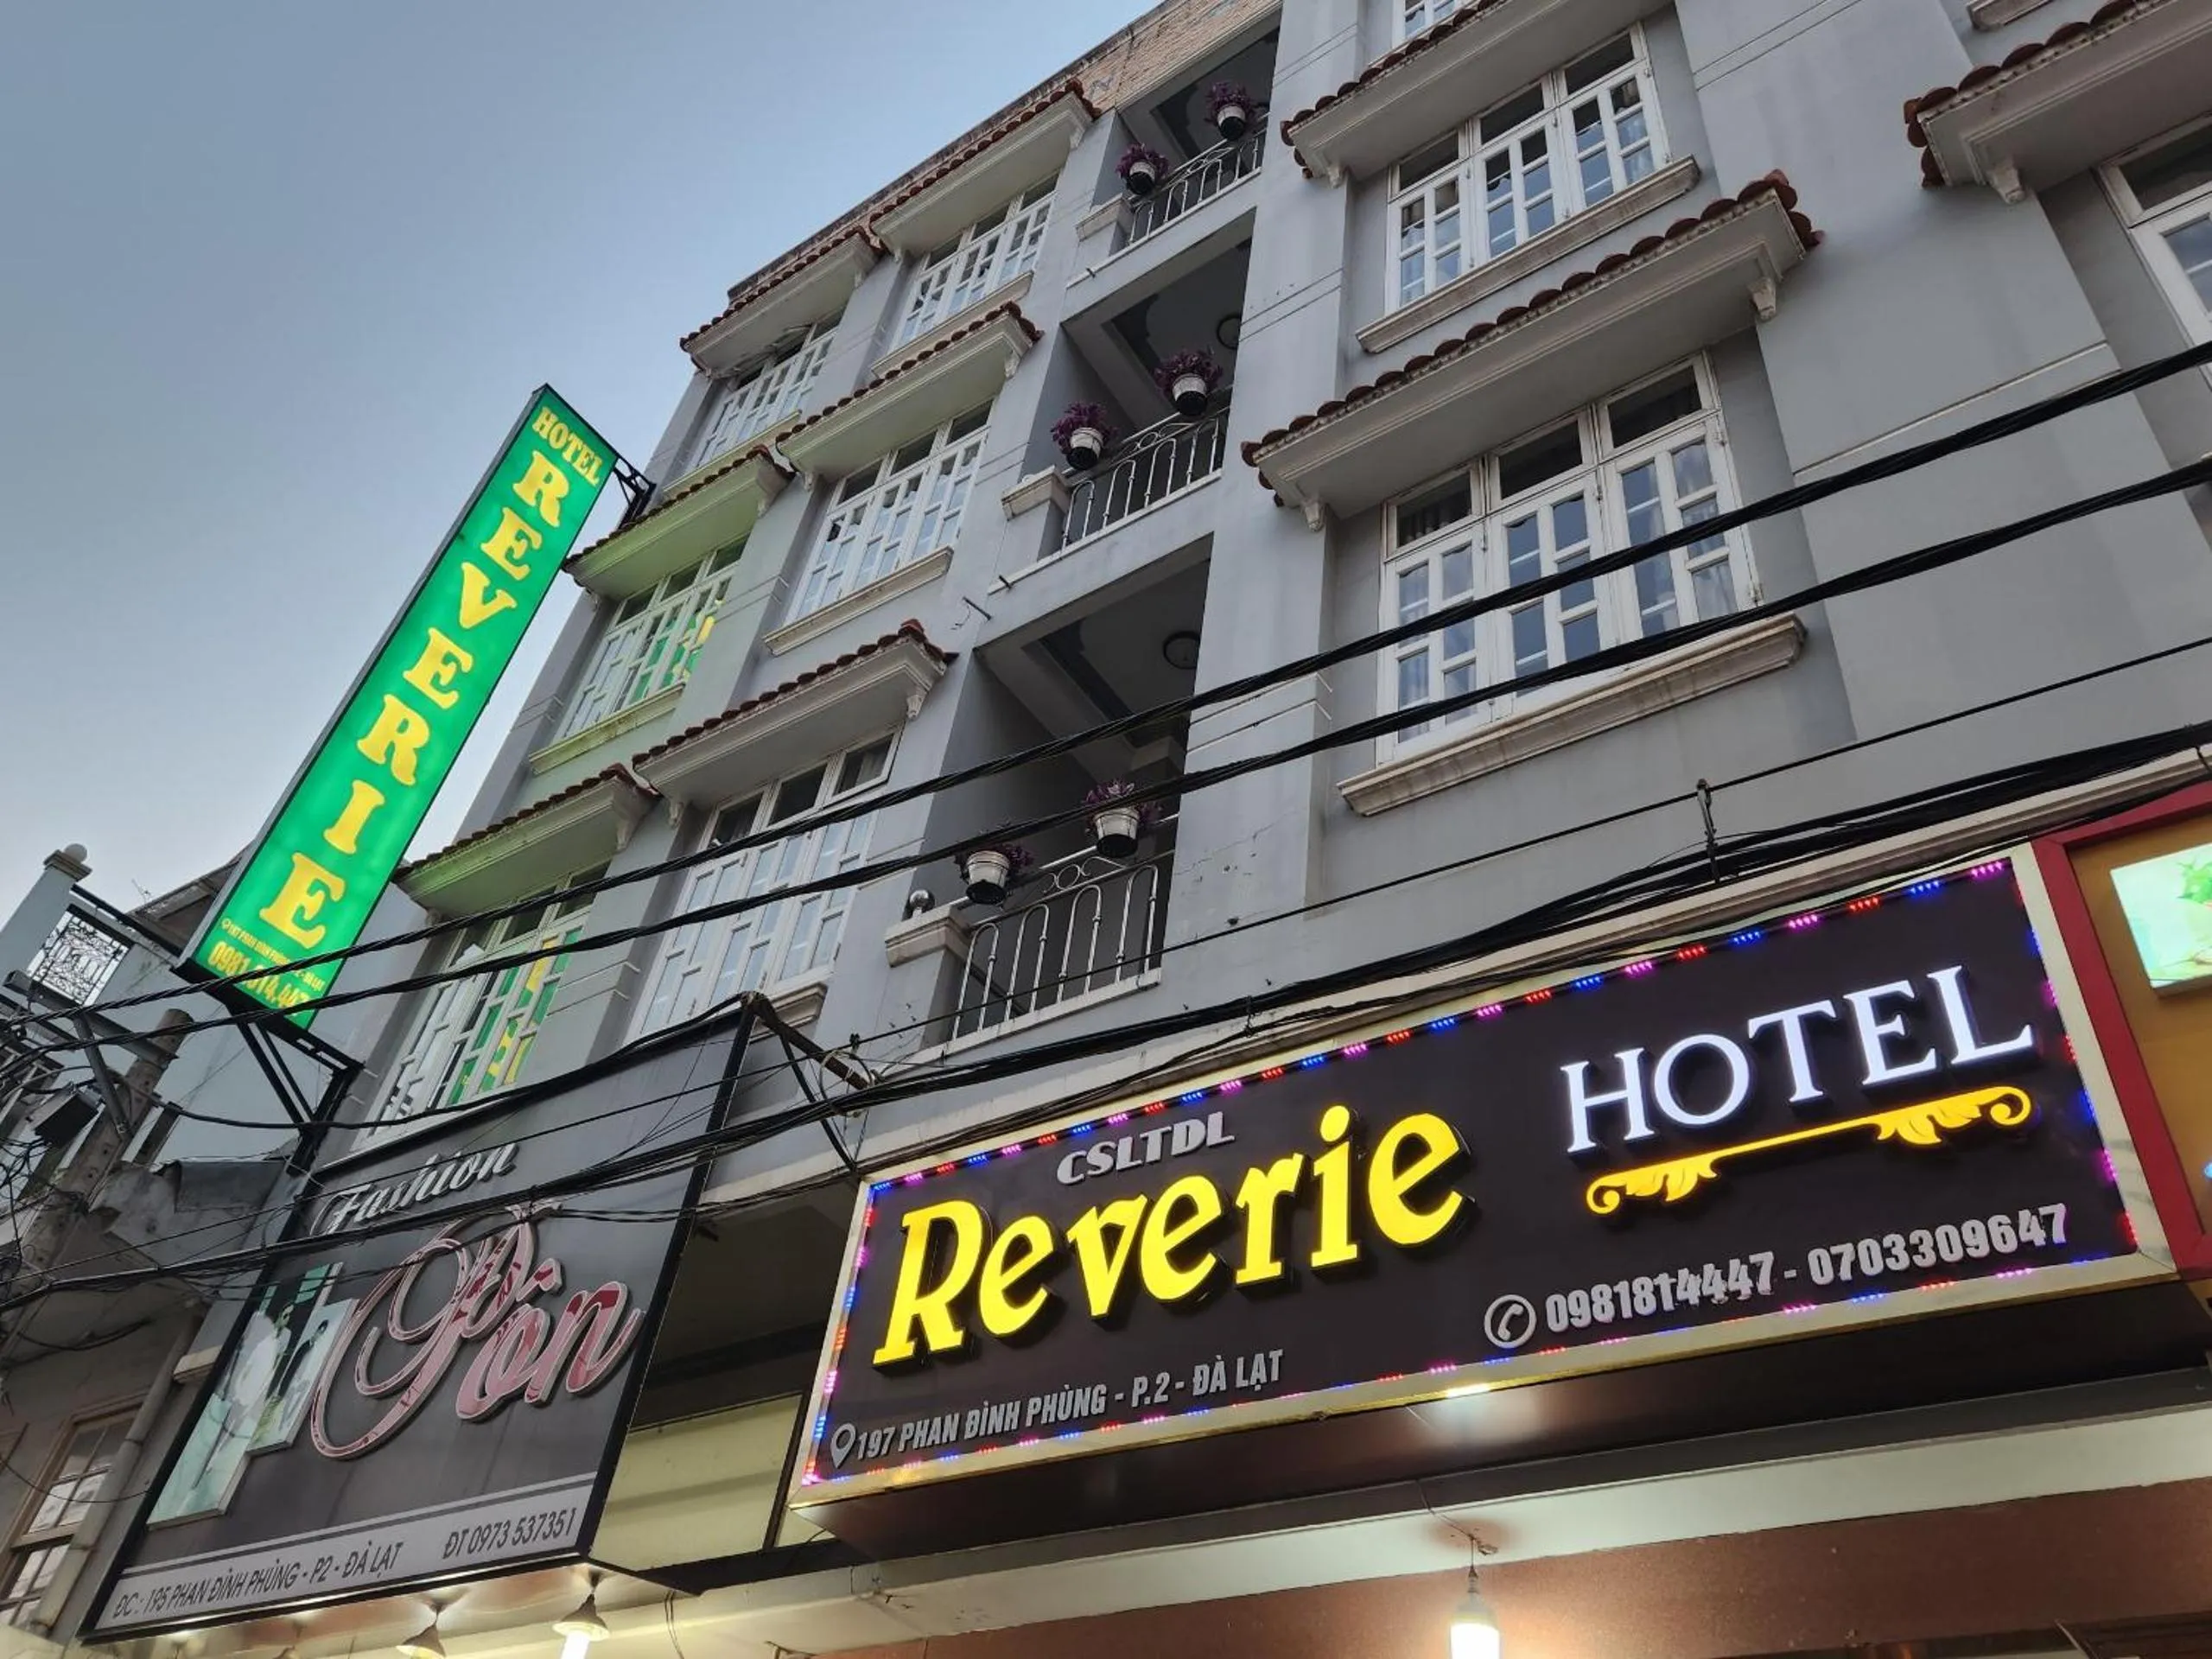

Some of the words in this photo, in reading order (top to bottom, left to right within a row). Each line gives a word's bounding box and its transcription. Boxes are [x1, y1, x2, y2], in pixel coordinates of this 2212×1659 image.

[532, 406, 603, 486] HOTEL
[258, 450, 569, 949] REVERIE
[1560, 965, 2033, 1153] HOTEL
[308, 1142, 518, 1236] Fashion
[1057, 1111, 1235, 1185] CSLTDL
[874, 1105, 1463, 1365] Reverie
[1545, 1251, 1774, 1332] 0981814447
[1807, 1203, 2067, 1286] 0703309647
[856, 1427, 895, 1460] 197
[898, 1412, 959, 1452] PHAN
[963, 1400, 1021, 1440] ĐÌNH
[1026, 1383, 1108, 1427] PHÙNG
[1192, 1354, 1227, 1396] ĐÀ
[1236, 1349, 1283, 1391] LẠT
[467, 1519, 512, 1554] 0973
[511, 1507, 577, 1546] 537351
[143, 1586, 173, 1616] 195
[166, 1579, 210, 1611] PHAN
[309, 1555, 334, 1584] P2
